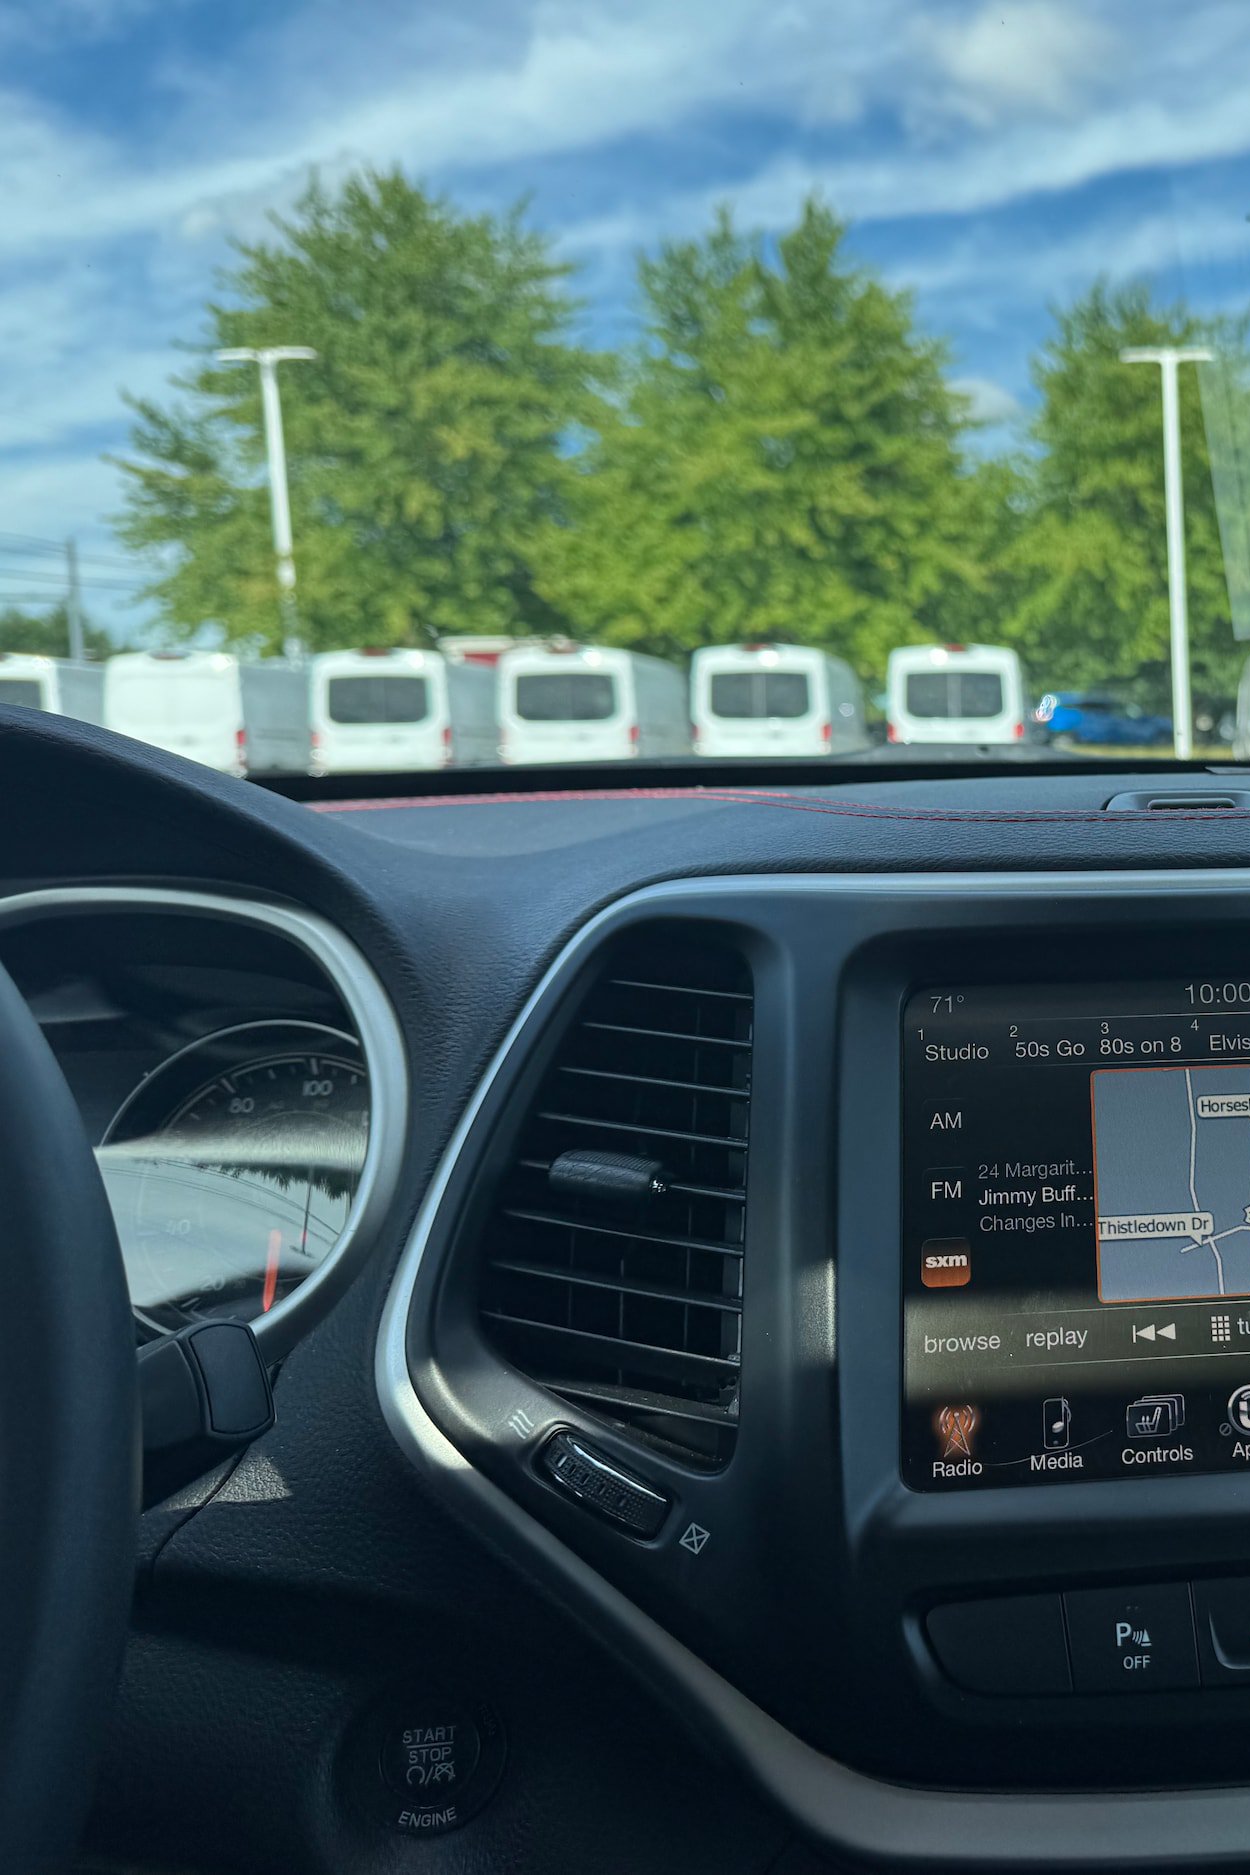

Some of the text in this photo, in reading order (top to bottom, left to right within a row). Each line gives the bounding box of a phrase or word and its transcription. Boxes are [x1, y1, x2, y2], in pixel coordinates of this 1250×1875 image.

[930, 994, 965, 1014] 71°
[917, 1028, 924, 1041] 1
[1009, 1024, 1018, 1038] 2
[1100, 1021, 1110, 1035] 3
[1190, 1019, 1200, 1031] 4
[925, 1043, 989, 1062] Studio
[1015, 1039, 1085, 1058] 50s Go
[1099, 1036, 1182, 1055] 80s on 8
[302, 1080, 333, 1096] 100
[929, 1111, 962, 1130] AM
[978, 1163, 1000, 1180] 24
[931, 1180, 962, 1200] FM
[978, 1188, 1037, 1207] Jimmy
[979, 1215, 1056, 1233] Changes
[1098, 1216, 1209, 1235] Thistledown Dr
[925, 1254, 968, 1269] sxm
[924, 1334, 1001, 1354] browse
[1026, 1326, 1088, 1351] replay
[1030, 1451, 1084, 1471] Media
[1121, 1444, 1194, 1465] Controls
[932, 1459, 983, 1478] Radio
[1123, 1654, 1151, 1670] OFF
[402, 1725, 457, 1744] START
[408, 1747, 452, 1764] STOP
[398, 1806, 457, 1828] ENGINE
